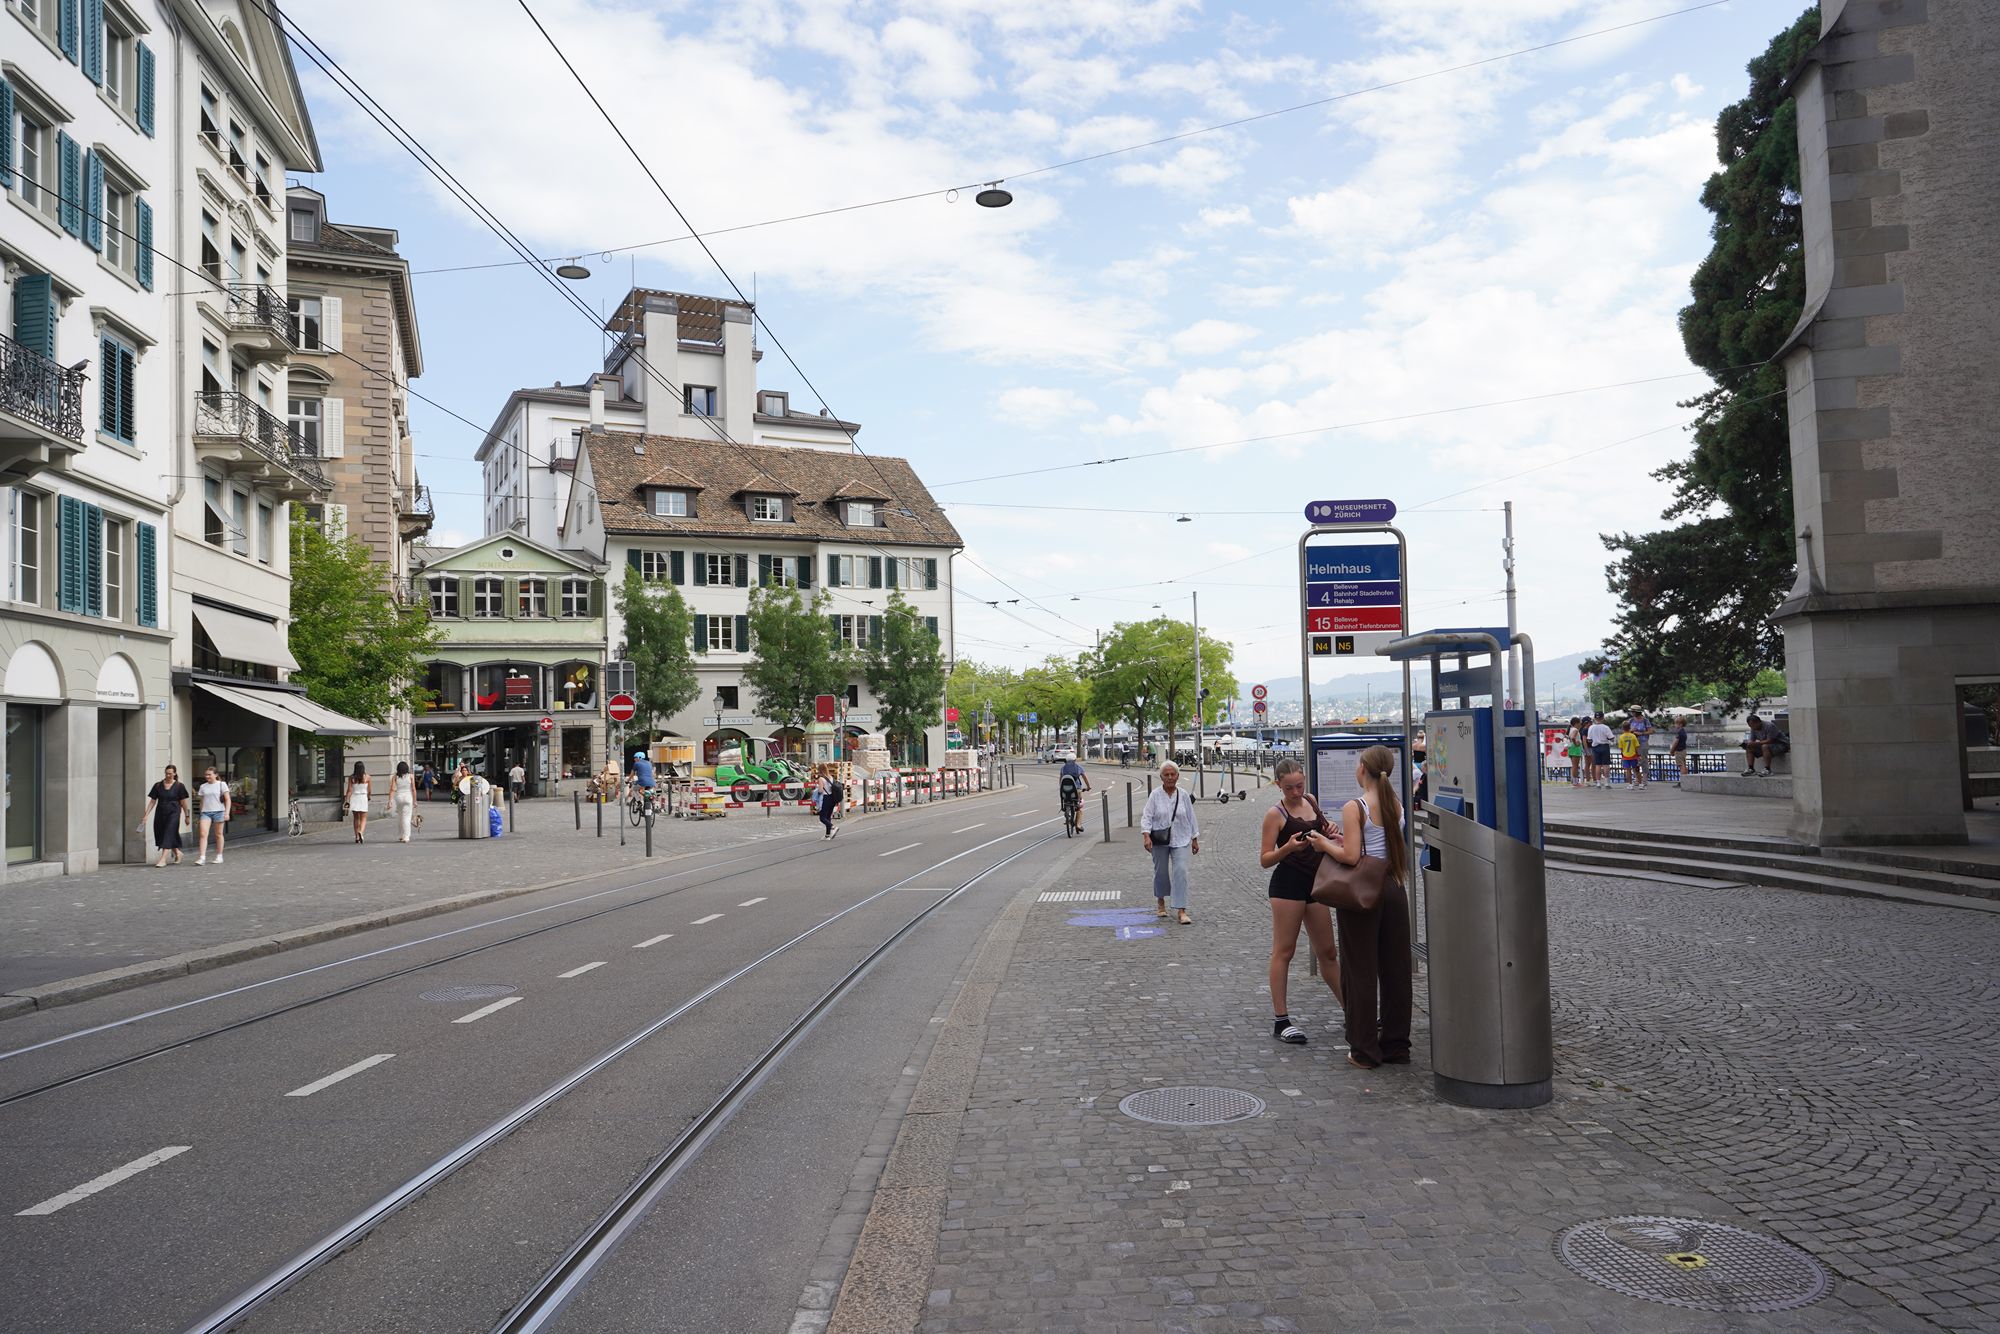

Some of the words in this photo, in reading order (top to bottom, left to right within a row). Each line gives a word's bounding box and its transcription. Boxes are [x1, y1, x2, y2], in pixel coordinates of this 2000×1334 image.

[1334, 503, 1387, 511] MUSEUMSNETZ
[1309, 563, 1372, 575] Helmhaus
[1320, 591, 1331, 604] 4
[1315, 617, 1331, 630] 15
[1315, 643, 1329, 651] N4
[1338, 642, 1352, 650] N5
[1624, 740, 1632, 753] 7
